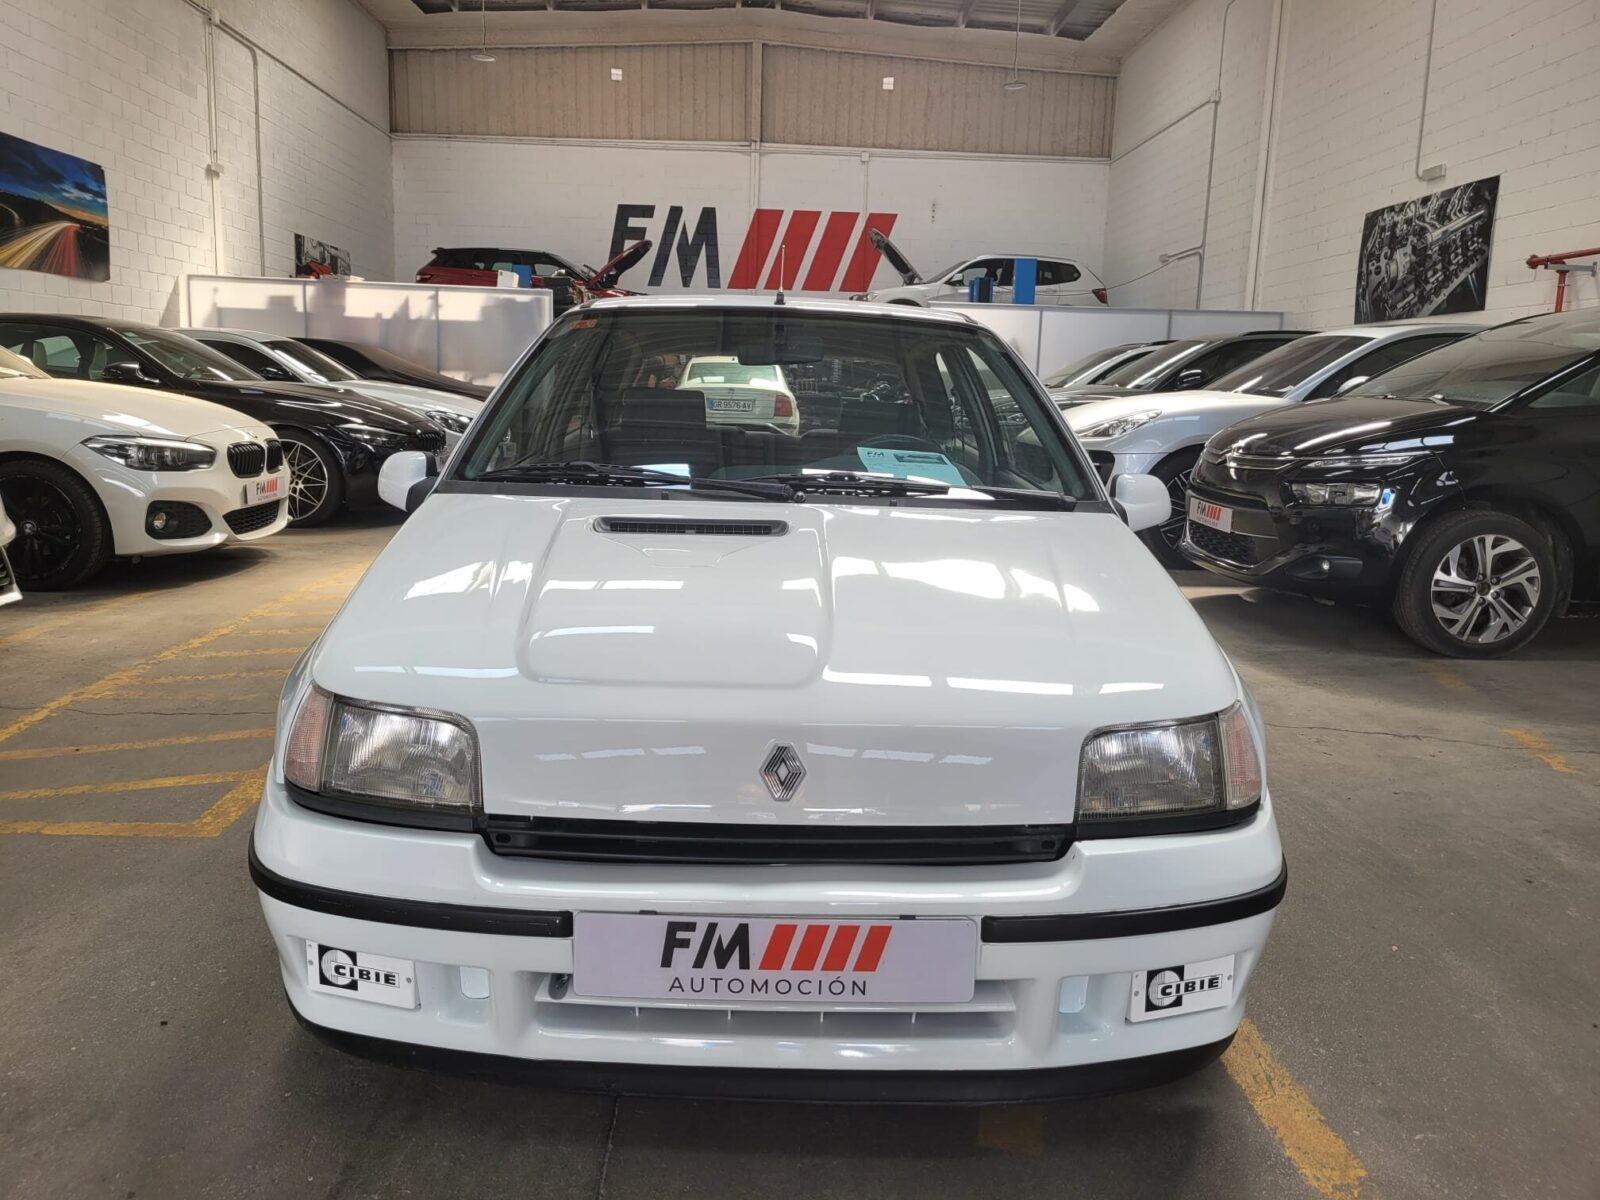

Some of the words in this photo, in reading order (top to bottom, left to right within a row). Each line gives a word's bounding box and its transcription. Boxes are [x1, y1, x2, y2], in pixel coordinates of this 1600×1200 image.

[607, 204, 721, 288] FM
[660, 921, 750, 970] FM
[668, 976, 867, 996] AUTOMOCIÓN
